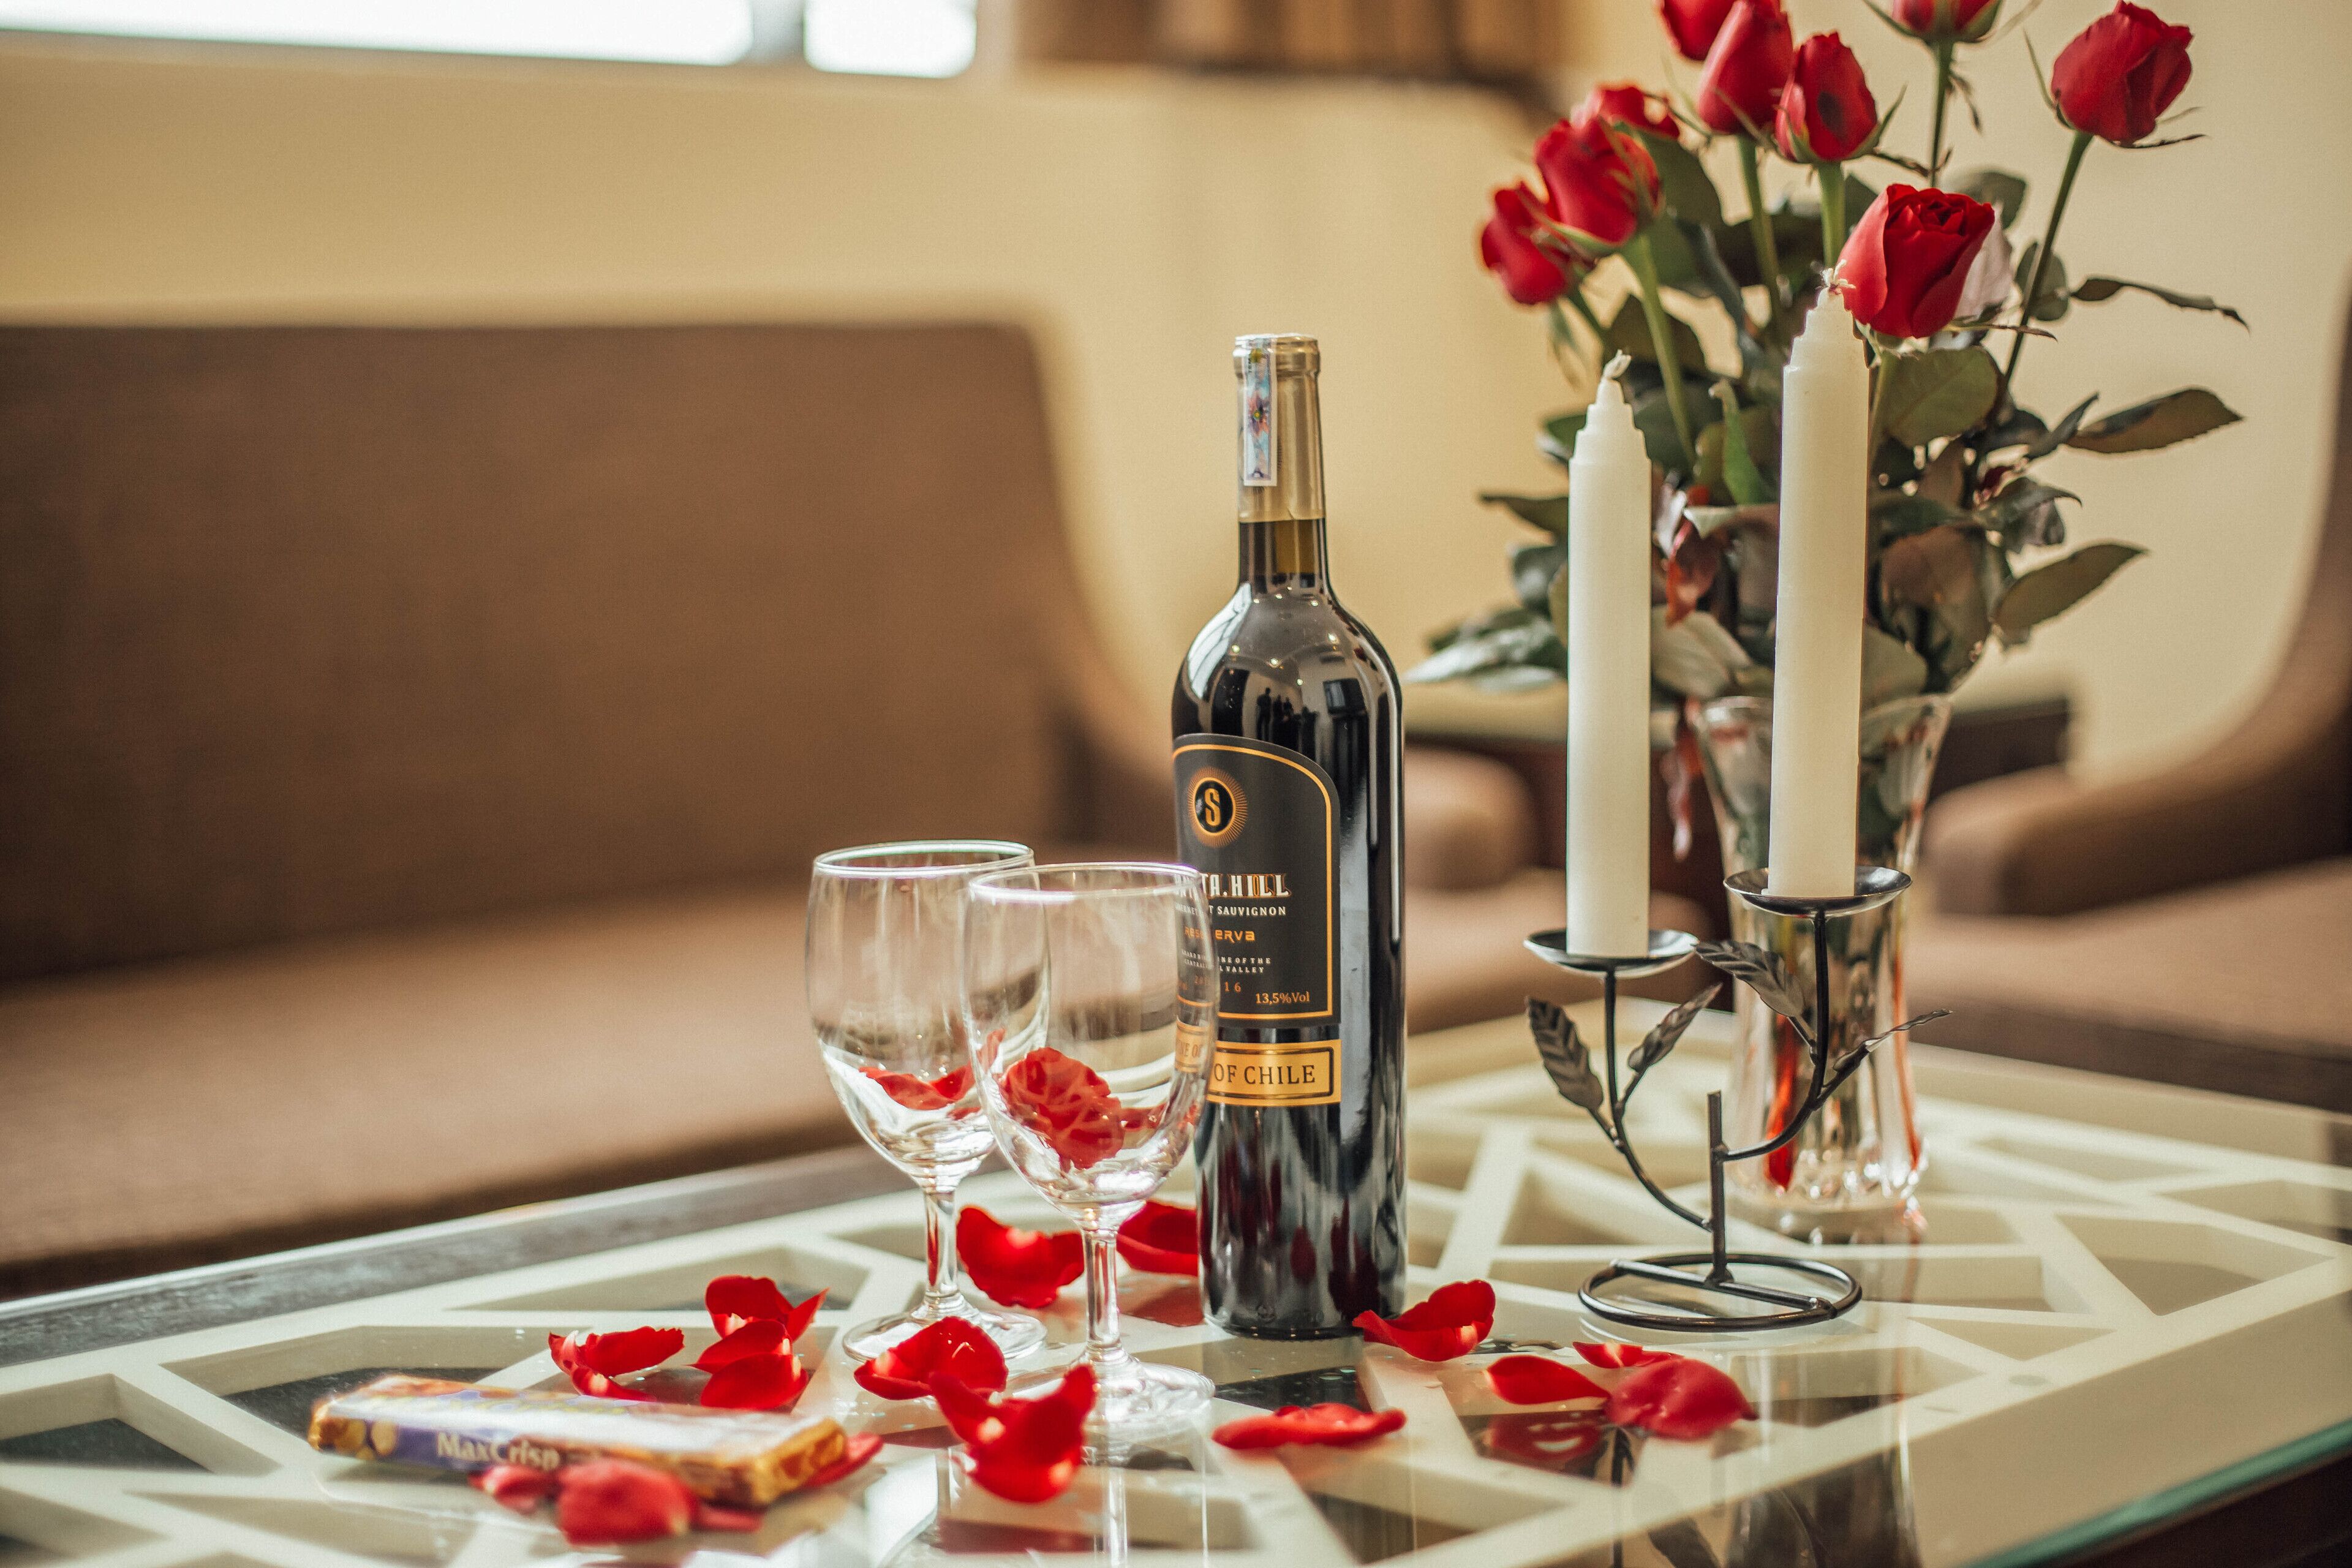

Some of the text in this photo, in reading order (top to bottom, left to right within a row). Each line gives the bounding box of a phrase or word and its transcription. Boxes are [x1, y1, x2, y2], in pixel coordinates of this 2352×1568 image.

[1204, 788, 1221, 826] S
[1217, 905, 1286, 917] SAUVIGNON
[1256, 991, 1310, 1005] 13,5%Vol
[1214, 1063, 1315, 1084] OF CHILE
[437, 1431, 561, 1471] MaxCrisp
